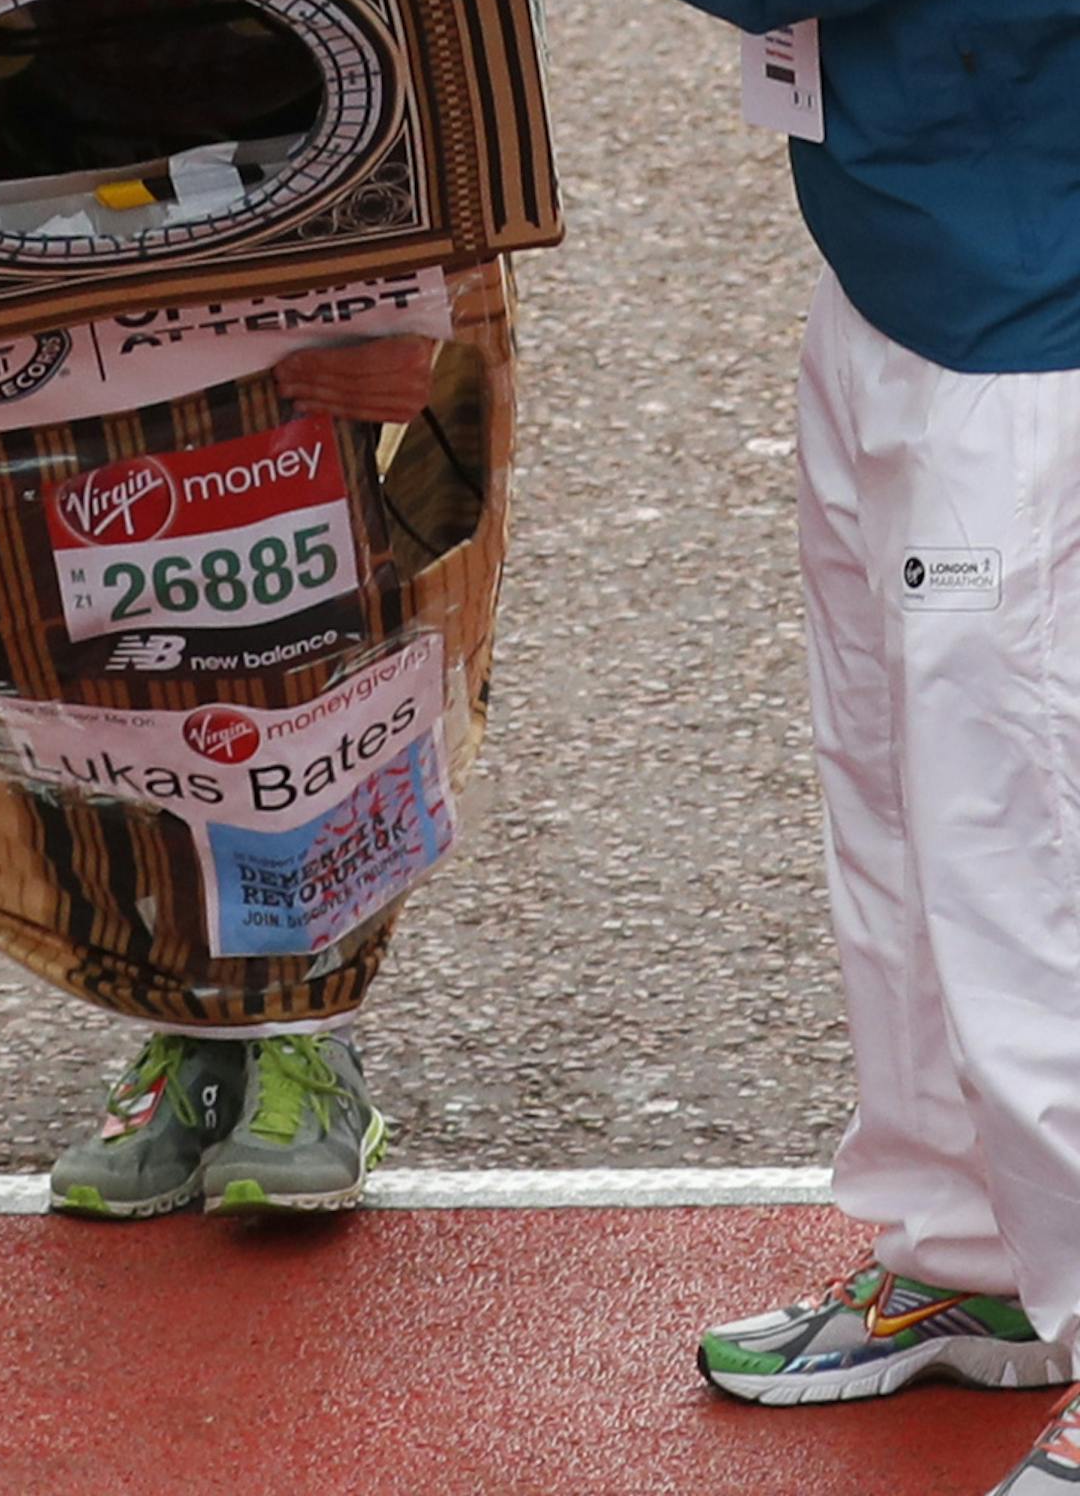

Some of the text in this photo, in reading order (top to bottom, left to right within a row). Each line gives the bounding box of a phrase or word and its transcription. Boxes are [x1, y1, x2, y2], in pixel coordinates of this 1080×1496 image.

[66, 441, 323, 535] Virgin money
[71, 568, 87, 584] M
[102, 522, 338, 623] 26885
[929, 562, 978, 575] LONDON
[190, 629, 339, 671] new balance
[22, 696, 416, 812] Lukas Bates
[188, 712, 254, 758] Virgin
